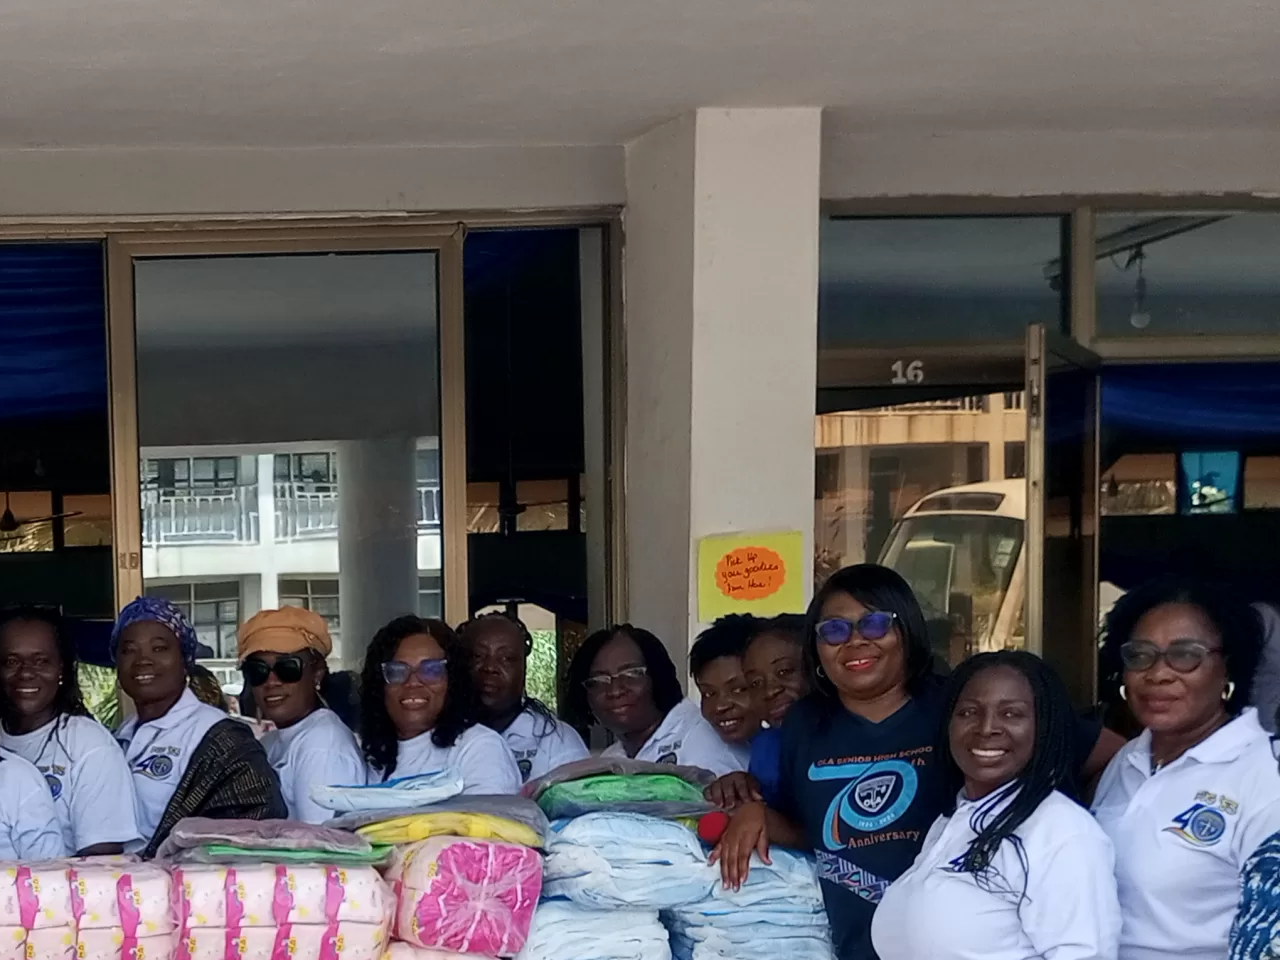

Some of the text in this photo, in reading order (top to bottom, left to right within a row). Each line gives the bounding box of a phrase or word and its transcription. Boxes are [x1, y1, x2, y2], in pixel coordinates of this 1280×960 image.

[891, 360, 924, 385] 16
[726, 555, 743, 567] Pick
[817, 746, 933, 766] OLA SENIOR HIGH SCHOO
[848, 830, 920, 849] Anniversary
